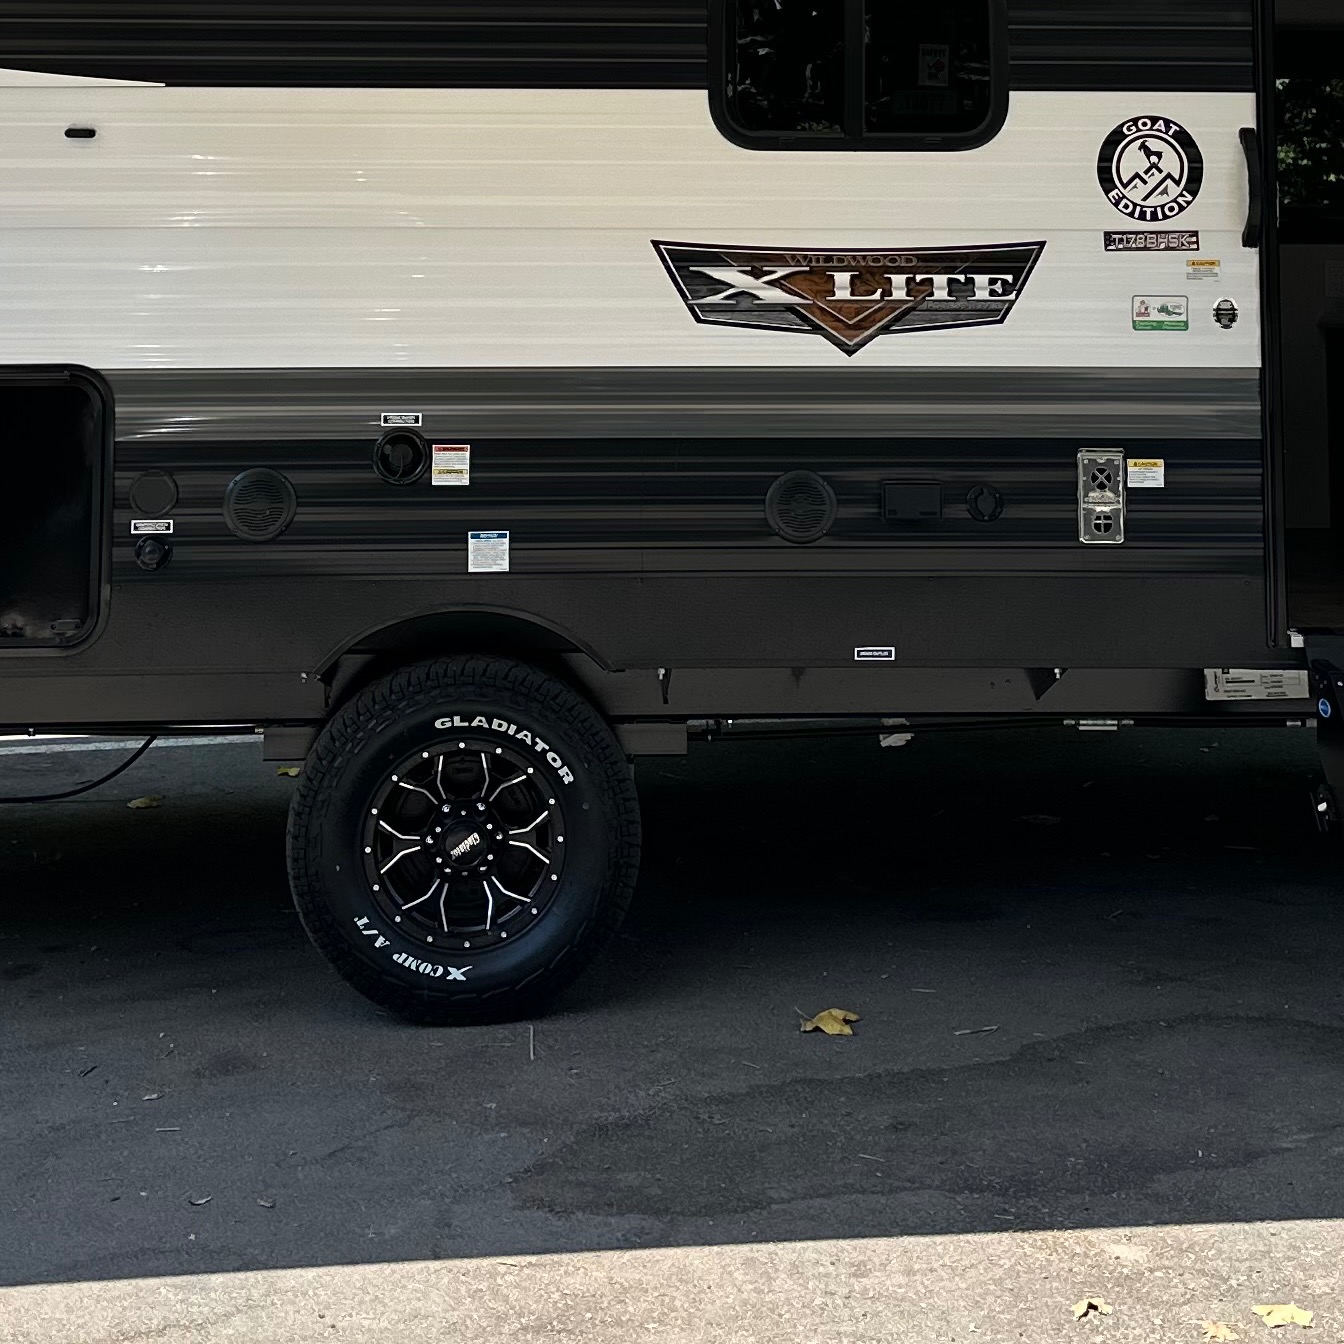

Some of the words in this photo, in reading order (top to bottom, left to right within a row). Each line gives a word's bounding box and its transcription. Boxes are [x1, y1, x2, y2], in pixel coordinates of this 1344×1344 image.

[1122, 118, 1180, 136] GOAT
[1108, 188, 1194, 221] EDITION
[784, 254, 918, 267] WILDWOOD
[688, 266, 814, 305] X
[825, 271, 1017, 302] LITE
[434, 715, 575, 785] GLADIATOR
[353, 915, 391, 949] A/T
[392, 952, 444, 978] COMP
[446, 965, 474, 981] X
